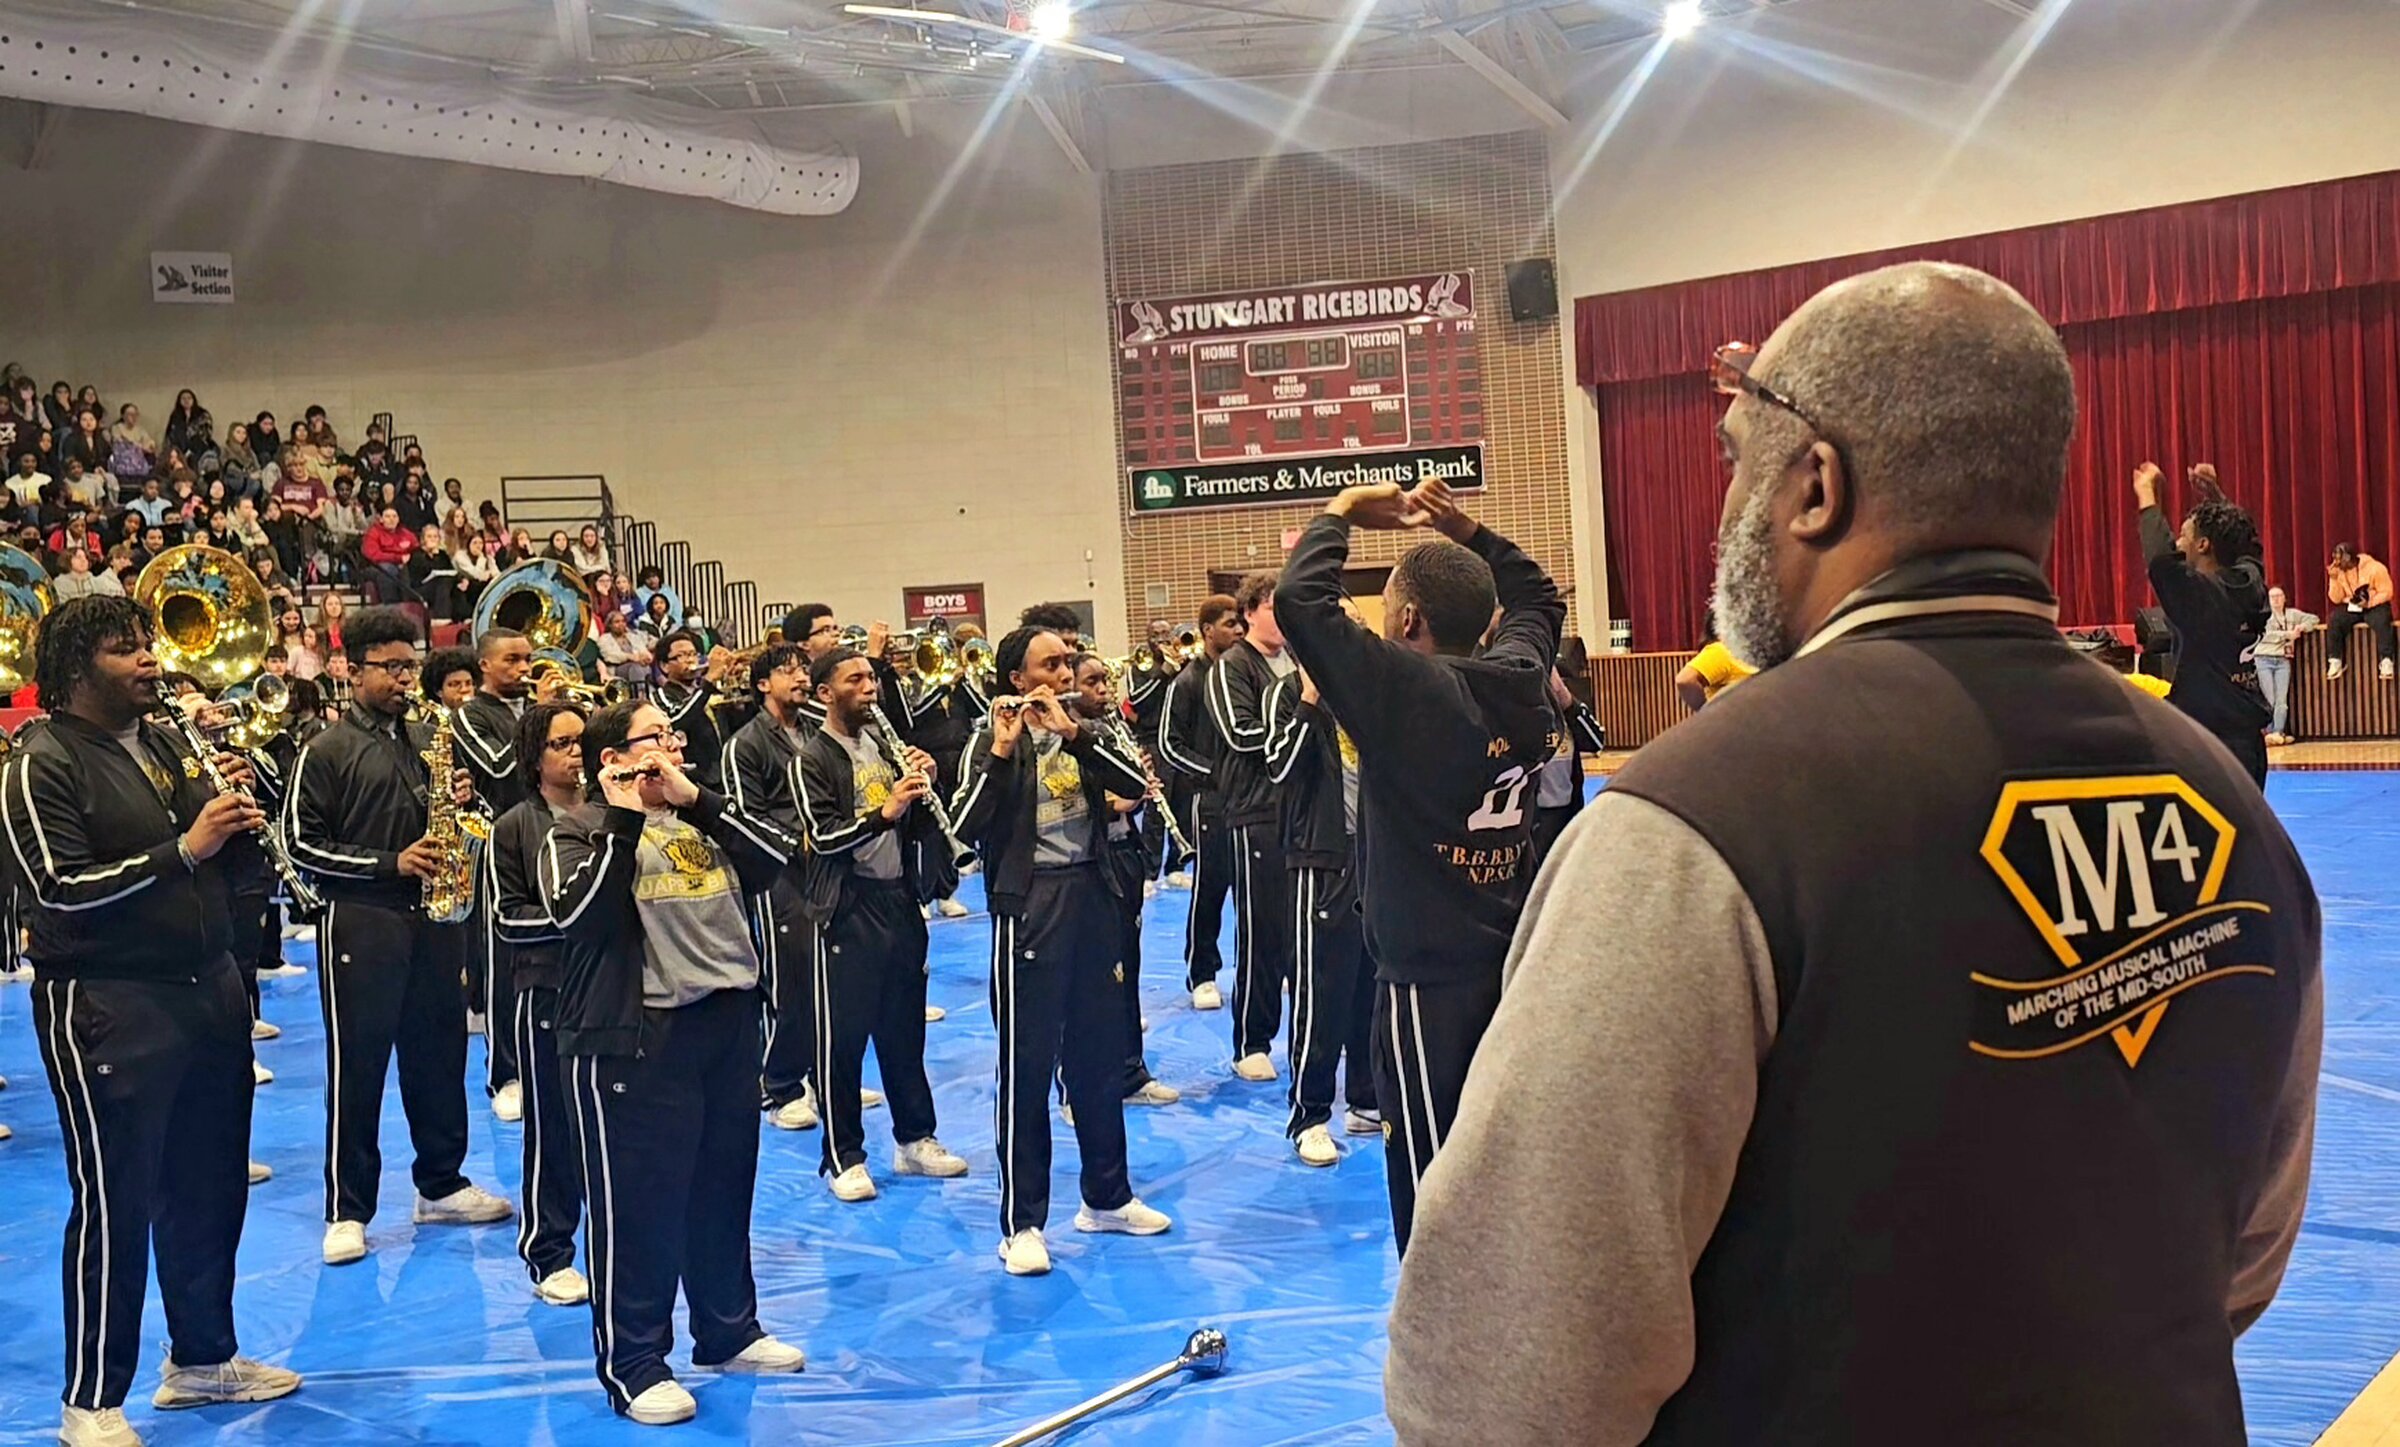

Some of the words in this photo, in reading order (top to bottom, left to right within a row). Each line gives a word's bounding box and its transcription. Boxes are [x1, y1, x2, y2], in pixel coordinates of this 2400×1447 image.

[191, 264, 229, 278] Visitor
[191, 281, 232, 295] Section
[1170, 295, 1296, 333] STUTTGART
[1302, 284, 1424, 321] RICEBIRDS
[1407, 324, 1424, 336] NO
[1455, 319, 1475, 332] PTS
[1349, 330, 1401, 349] VISITOR
[1124, 348, 1139, 359] NO
[1169, 343, 1189, 356] PTS
[1200, 344, 1239, 361] HOME
[1272, 383, 1307, 396] PERIOD
[1349, 383, 1382, 397] BONUS
[1218, 393, 1250, 407] BONUS
[1370, 399, 1401, 414] FOULS
[1202, 412, 1231, 425] FOULS
[1266, 406, 1302, 420] PLAYER
[1313, 403, 1342, 417] FOULS
[1244, 443, 1263, 456] TOL
[1342, 436, 1362, 448] TOL
[1183, 474, 1270, 497] Farmers
[1273, 468, 1296, 491] &
[1297, 462, 1414, 489] Merchants
[1416, 454, 1477, 481] Bank
[923, 593, 967, 608] BOYS
[2007, 976, 2099, 1026] MARCHING
[2100, 946, 2170, 989] MUSICAL
[2169, 916, 2241, 958] MACHINE
[2054, 1005, 2080, 1029] OF
[2083, 988, 2116, 1019] THE
[2118, 953, 2208, 1006] MID-SOUTH
